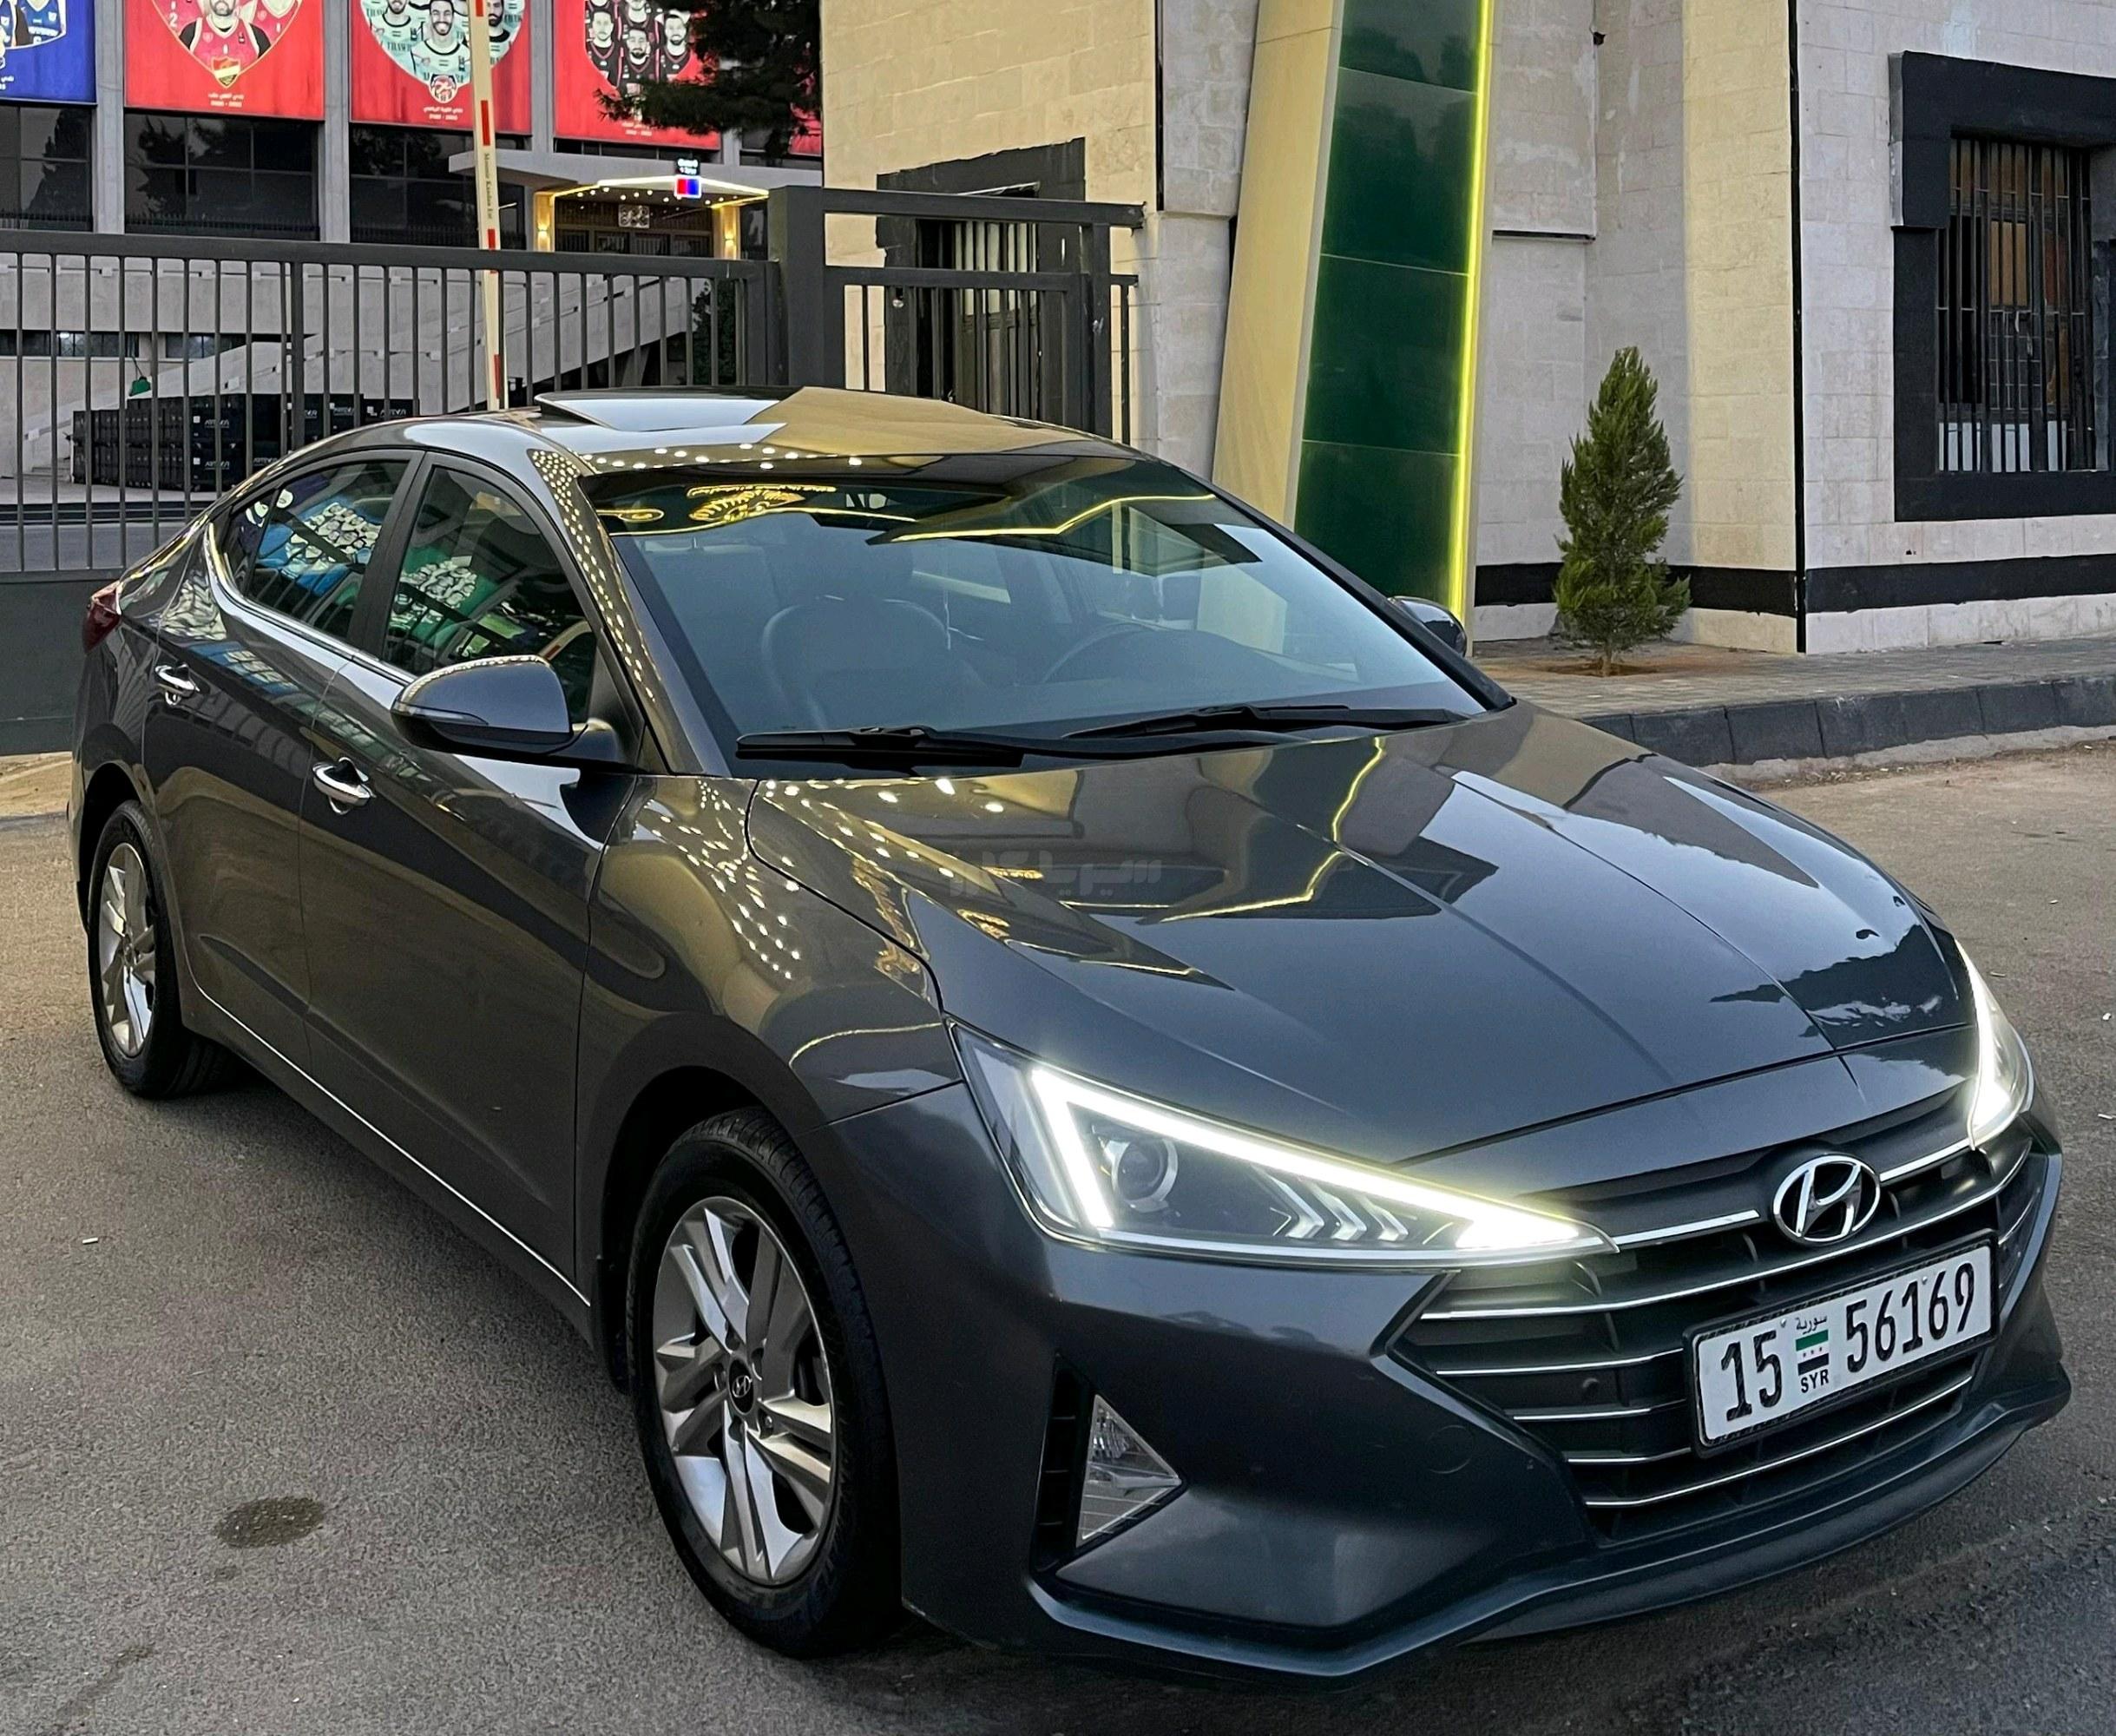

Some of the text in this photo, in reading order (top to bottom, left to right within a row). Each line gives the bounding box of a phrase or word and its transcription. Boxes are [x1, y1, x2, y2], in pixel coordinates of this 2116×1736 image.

[1795, 1316, 1828, 1335] سورية
[1721, 1262, 1975, 1422] 15 56169
[1800, 1369, 1830, 1393] SYR
